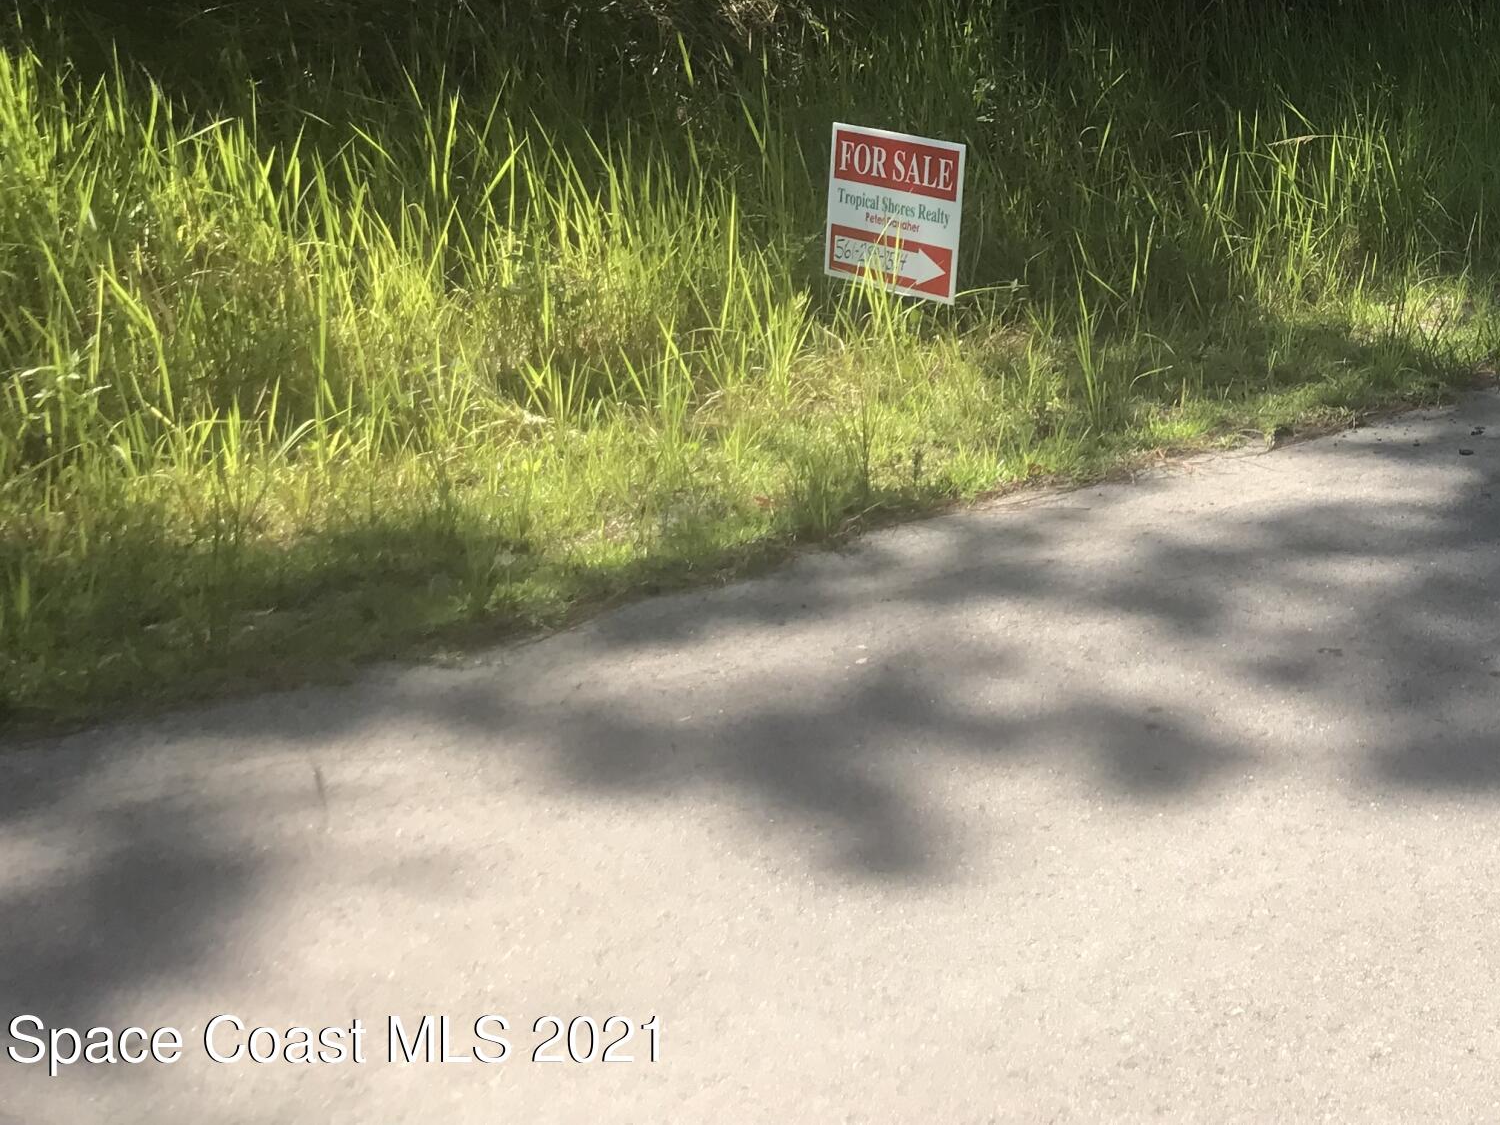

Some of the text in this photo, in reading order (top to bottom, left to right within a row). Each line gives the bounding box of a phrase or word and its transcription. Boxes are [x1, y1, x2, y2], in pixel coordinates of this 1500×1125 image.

[839, 140, 954, 191] FOR SALE
[837, 187, 951, 229] Tropical Shores Realty
